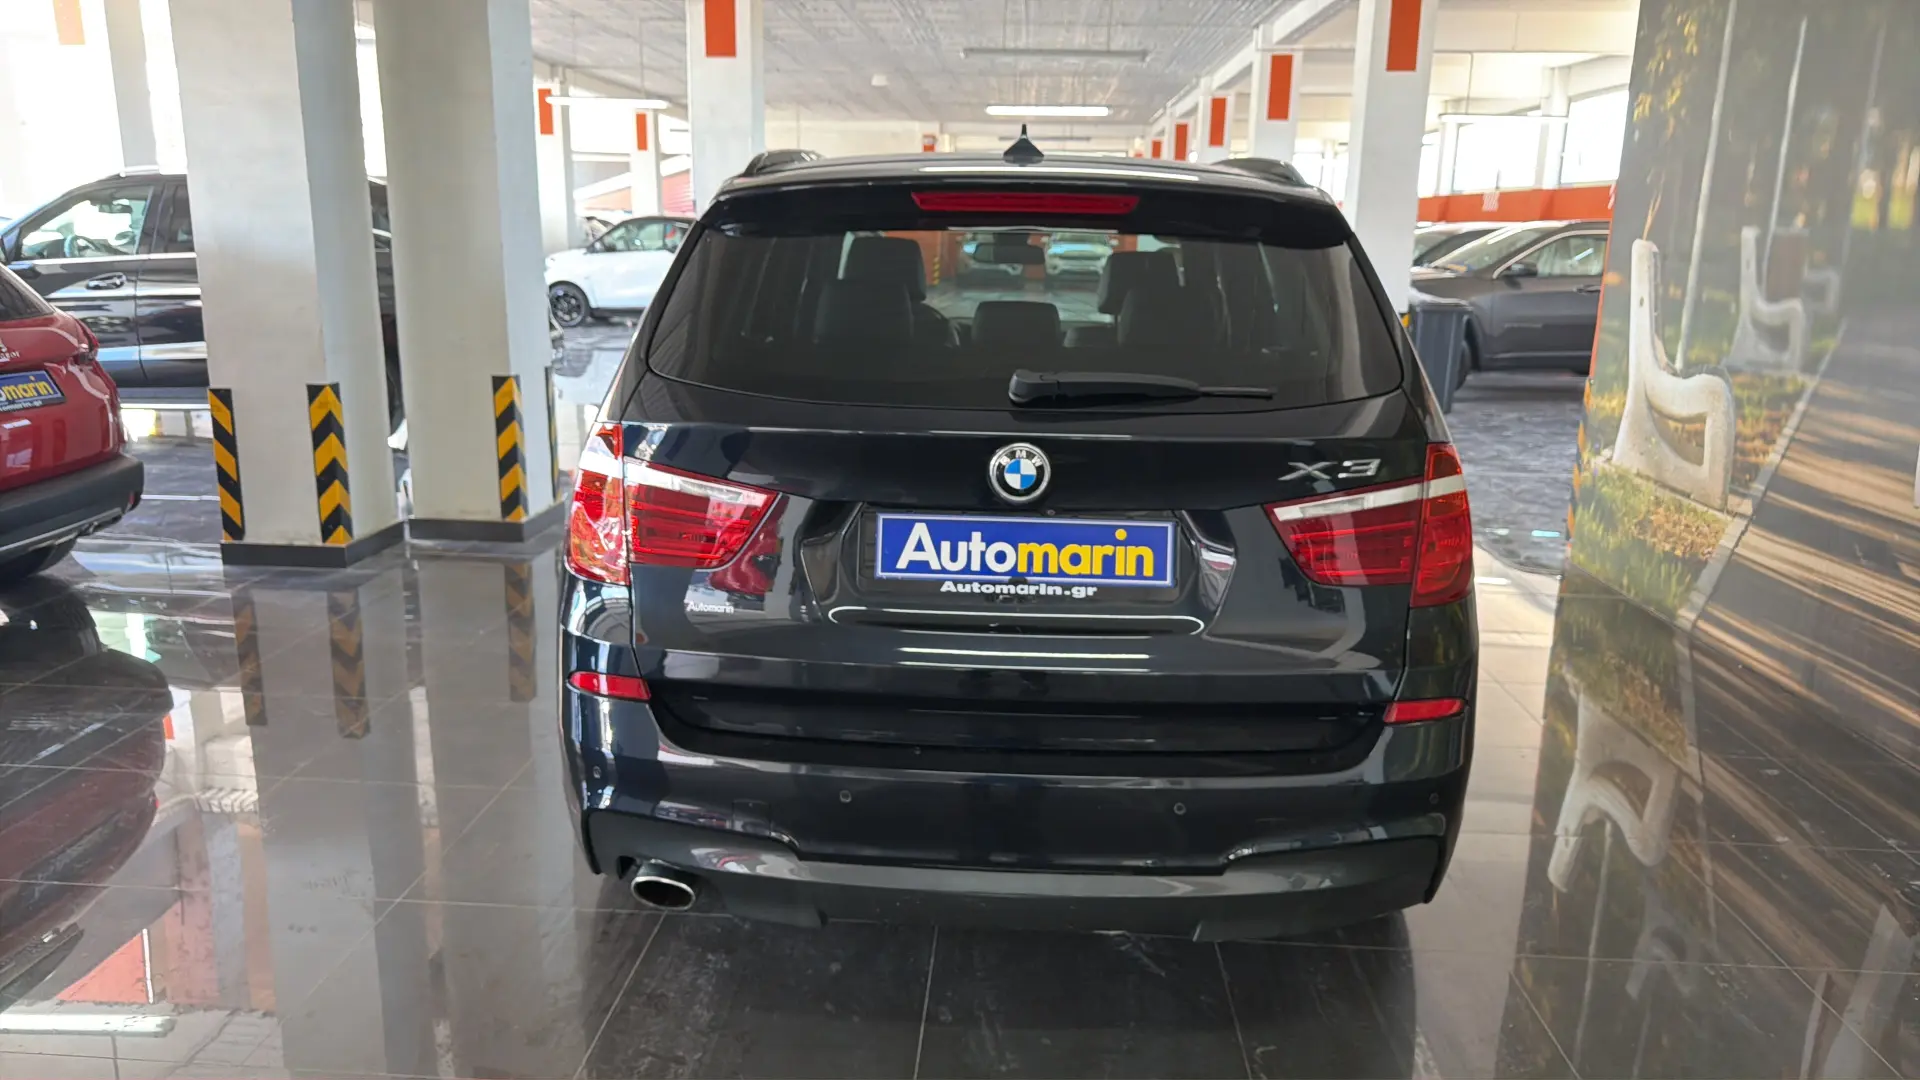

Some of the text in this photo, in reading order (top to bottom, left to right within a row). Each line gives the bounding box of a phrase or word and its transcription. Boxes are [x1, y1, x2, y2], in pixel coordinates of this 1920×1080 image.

[999, 449, 1043, 467] BMW
[1278, 459, 1381, 480] X3
[896, 522, 1154, 577] Automarin
[940, 580, 1097, 599] Automarin.gr
